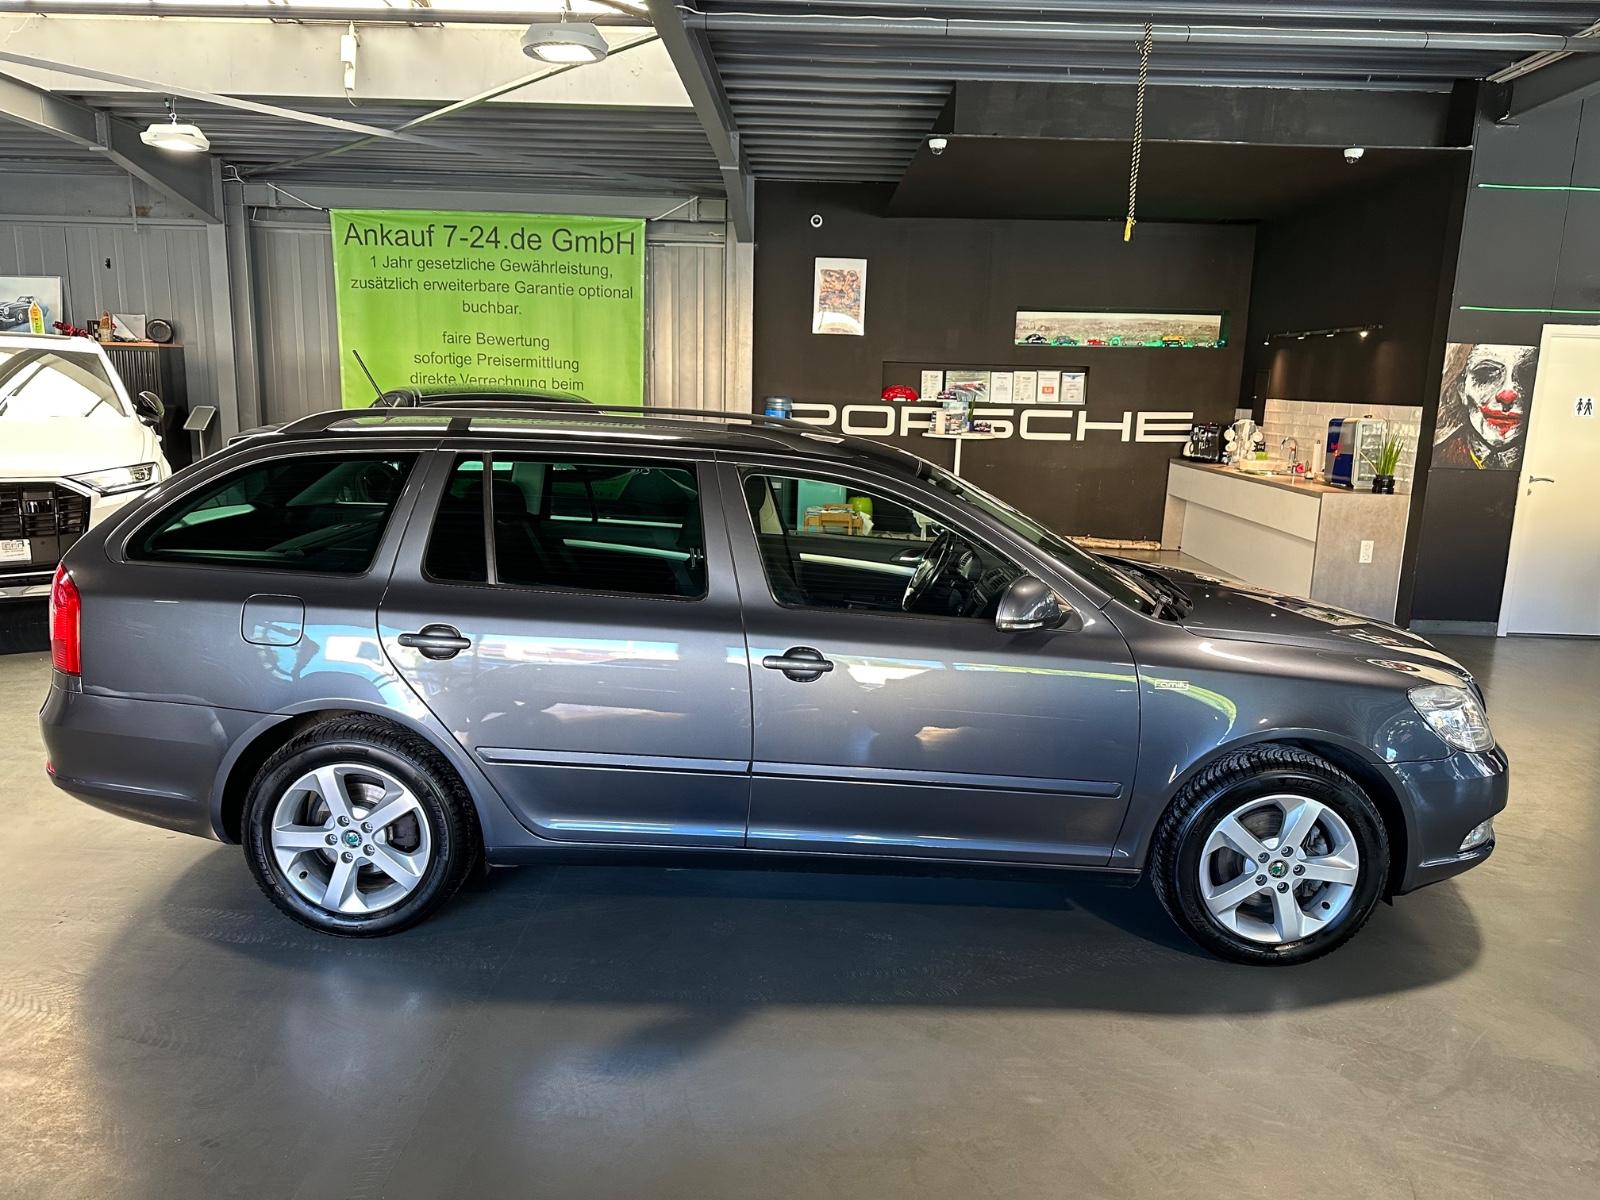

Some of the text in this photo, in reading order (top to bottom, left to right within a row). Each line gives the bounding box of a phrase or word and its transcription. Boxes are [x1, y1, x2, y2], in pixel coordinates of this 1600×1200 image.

[344, 223, 635, 255] Ankauf 7-24.de GmbH
[370, 256, 613, 279] 1 Jahr gesetzliche Gewährleistung,
[351, 277, 633, 300] zusätzlich erweiterbare Garantie optional
[462, 301, 522, 315] buchbar.
[442, 331, 550, 350] faire Bewertung
[414, 352, 579, 372] sofortige Preisermittlung
[410, 373, 584, 391] direkte Verrechnung beim
